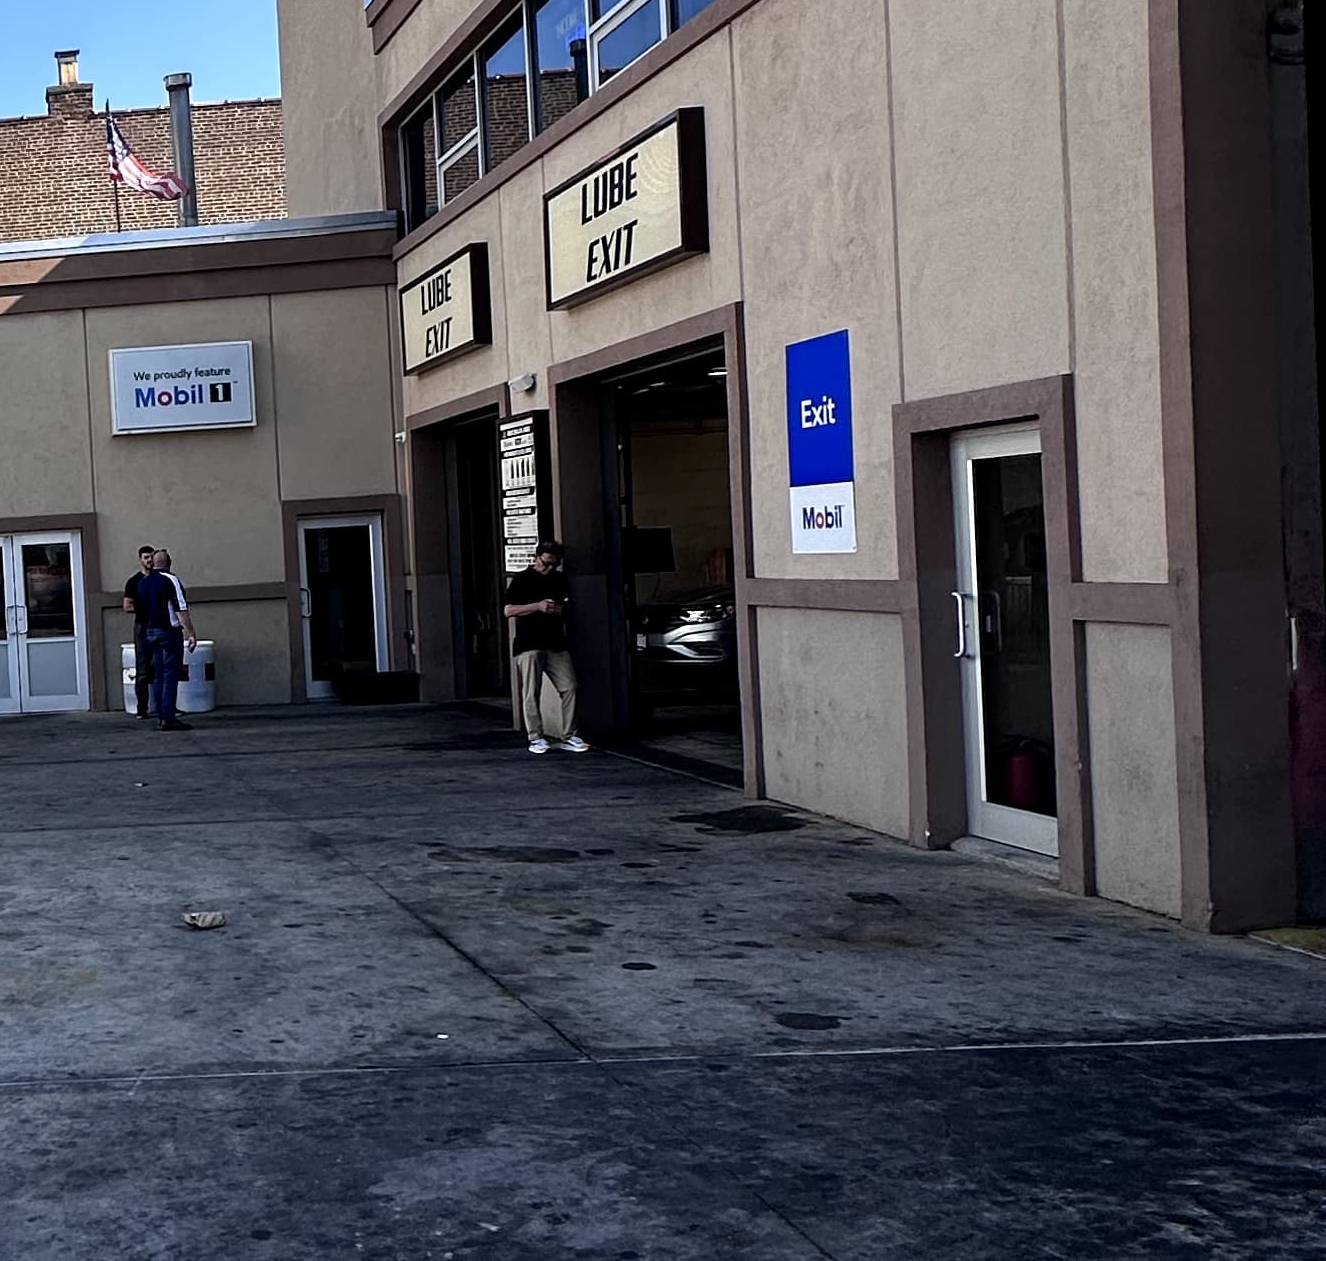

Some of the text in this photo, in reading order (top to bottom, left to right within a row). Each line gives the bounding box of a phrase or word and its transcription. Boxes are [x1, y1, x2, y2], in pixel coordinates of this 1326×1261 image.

[581, 152, 639, 226] LUBE
[586, 219, 638, 283] EXIT
[420, 269, 453, 317] LUBE
[424, 316, 453, 357] EXIT
[133, 367, 231, 382] We proudly feature
[135, 384, 204, 408] Mobil
[801, 395, 836, 428] Exit
[801, 504, 842, 531] Mobil
